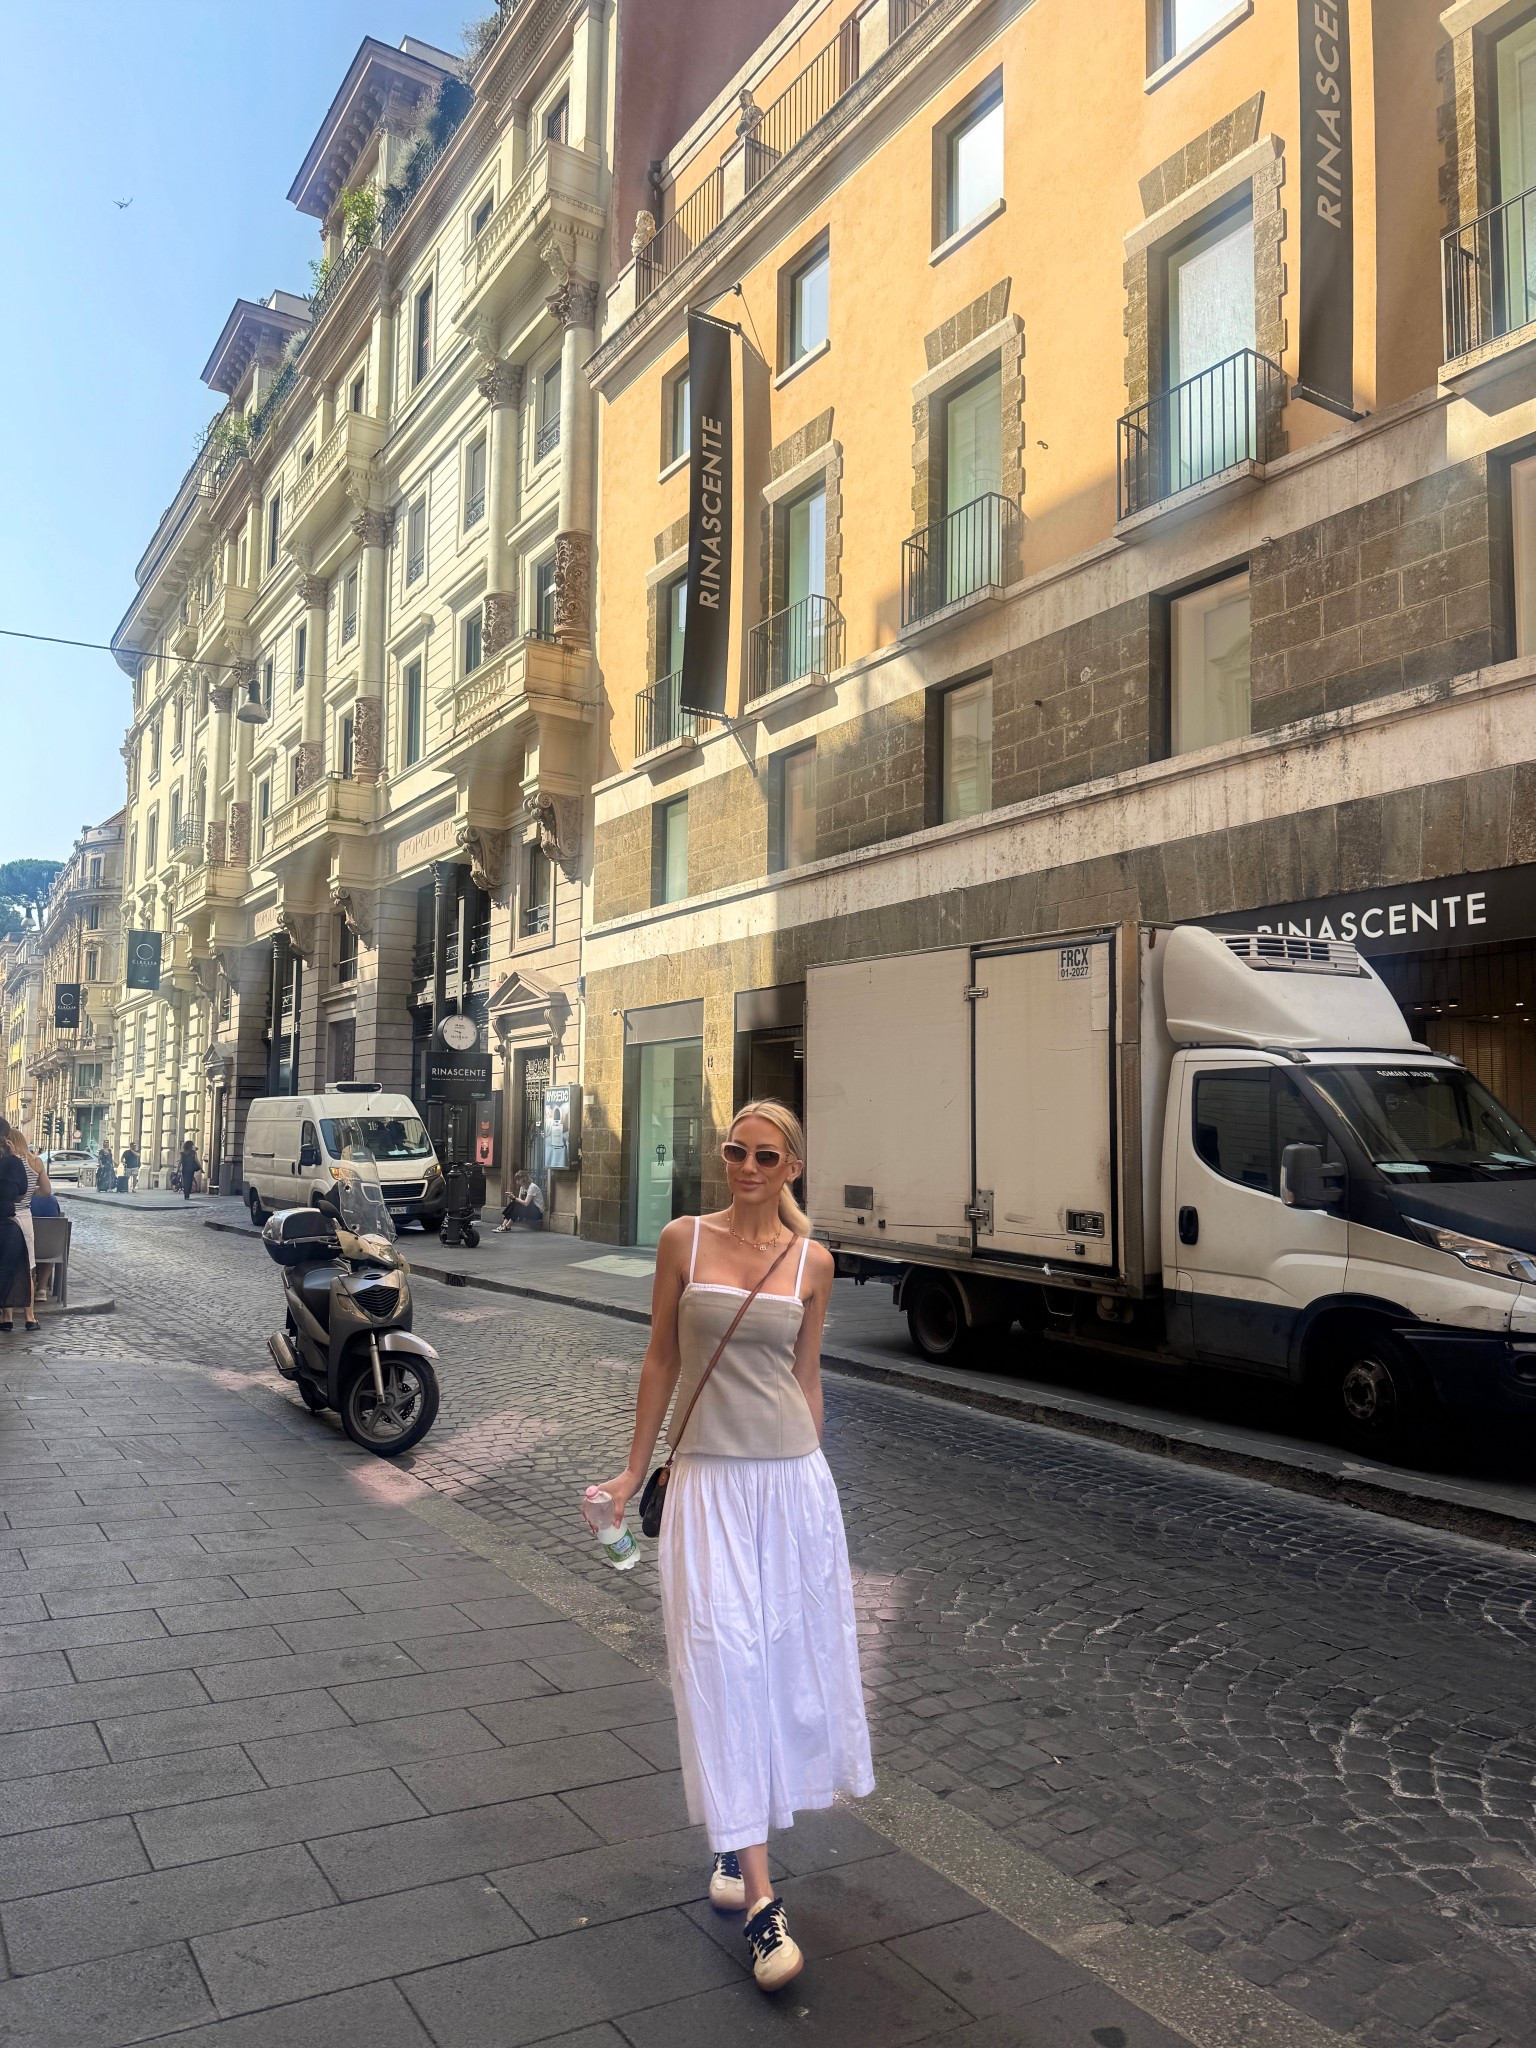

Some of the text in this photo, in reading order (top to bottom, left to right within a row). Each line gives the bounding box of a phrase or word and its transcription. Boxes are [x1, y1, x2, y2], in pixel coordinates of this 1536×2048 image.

[1314, 0, 1342, 229] RINASCE
[699, 415, 722, 610] RINASCENTE
[1060, 947, 1089, 968] FRCX
[1060, 966, 1089, 978] 01-2027
[431, 1067, 487, 1077] RINASCENTE
[546, 1089, 569, 1103] BYREDO
